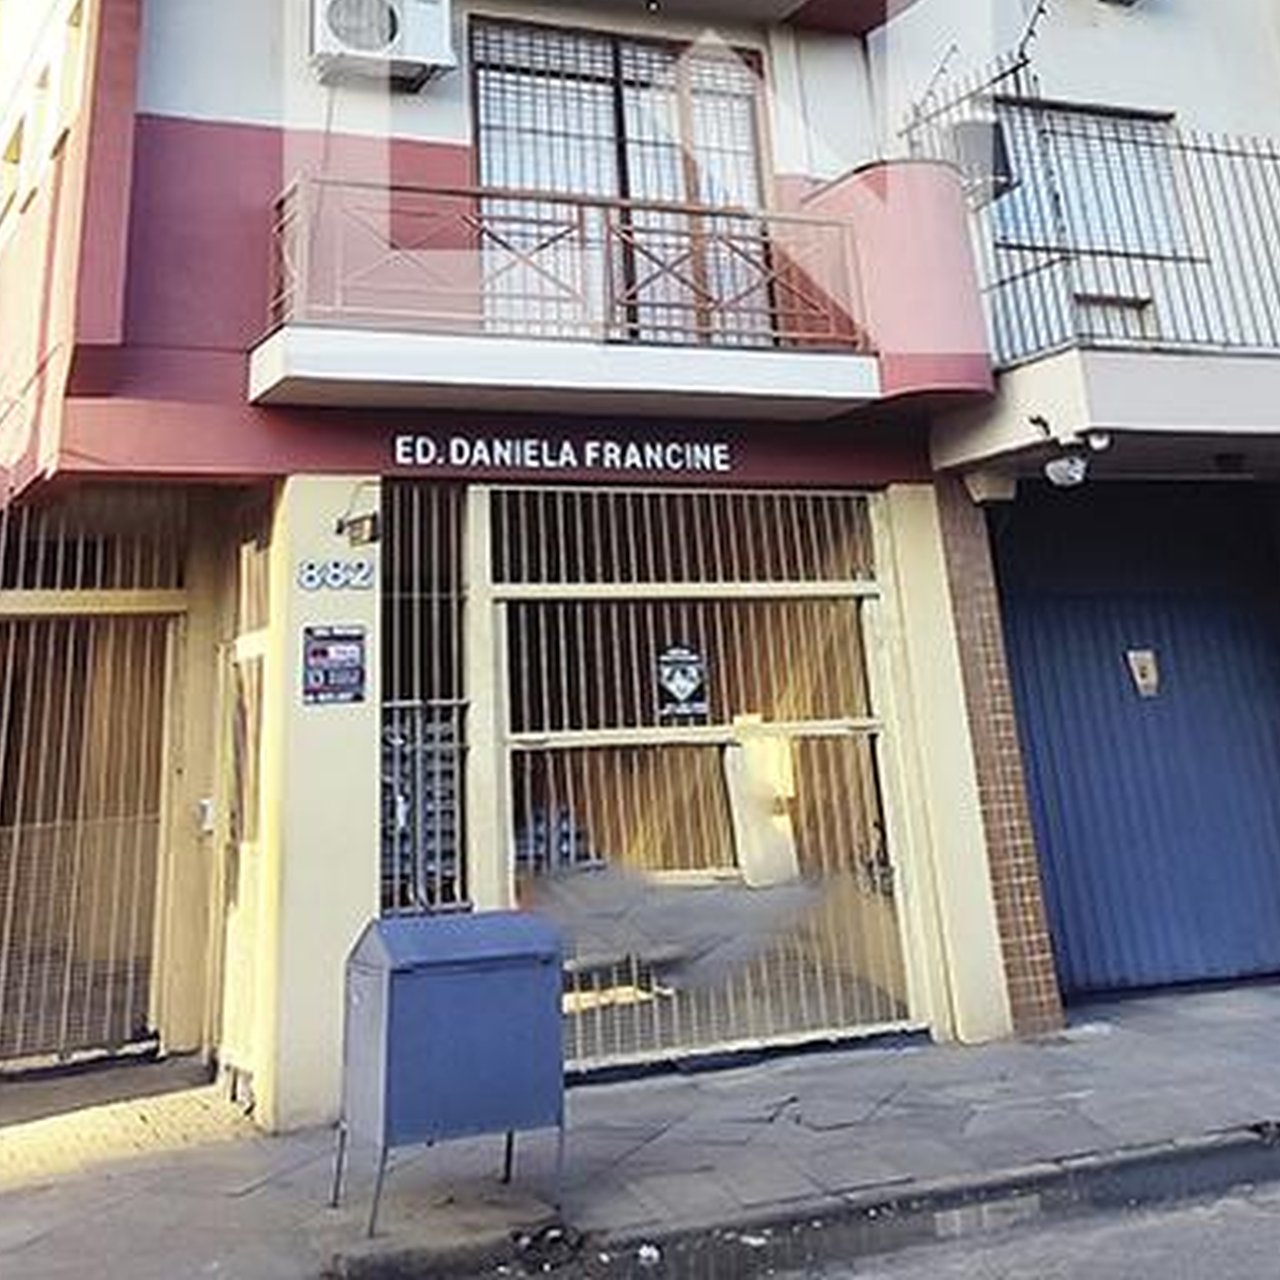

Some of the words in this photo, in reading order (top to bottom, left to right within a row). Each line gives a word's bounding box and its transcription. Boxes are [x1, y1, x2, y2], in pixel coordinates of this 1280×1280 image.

[394, 435, 445, 466] ED.
[449, 436, 579, 469] DANIELA
[583, 440, 732, 471] FRANCINE
[298, 558, 373, 590] 882
